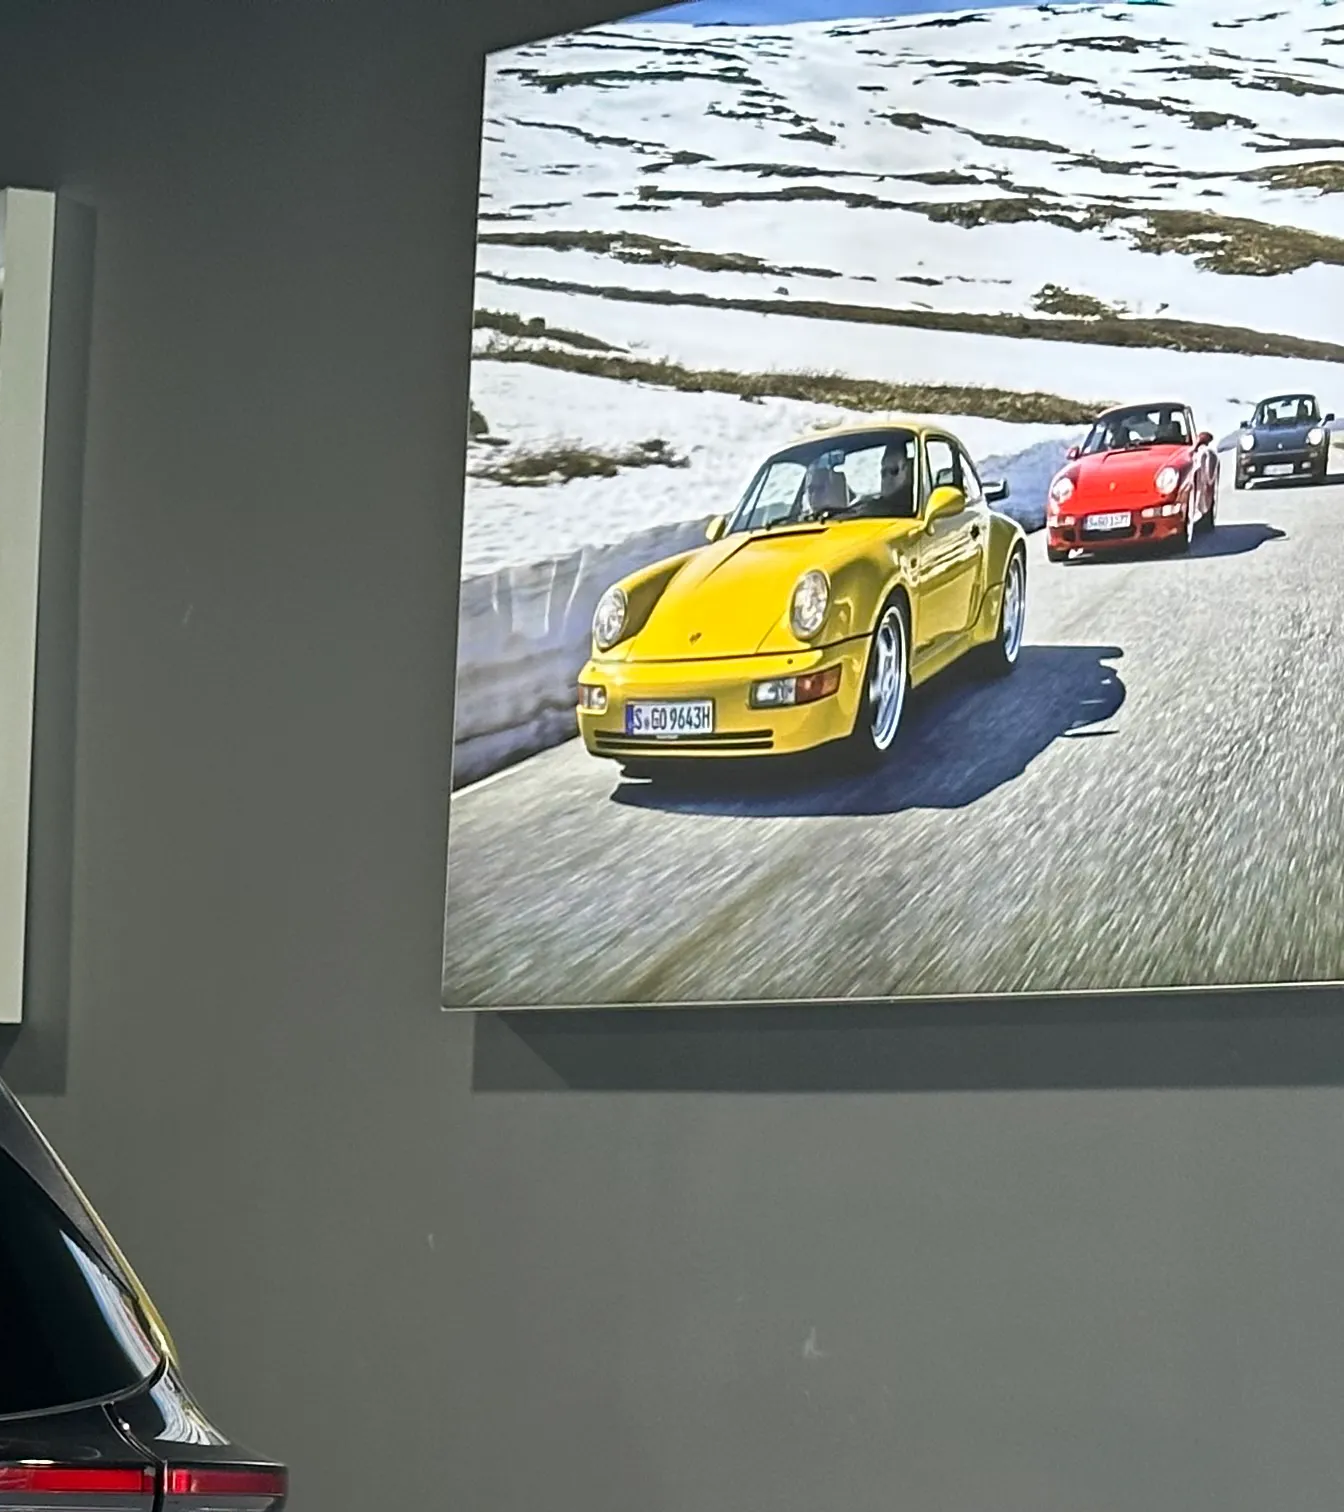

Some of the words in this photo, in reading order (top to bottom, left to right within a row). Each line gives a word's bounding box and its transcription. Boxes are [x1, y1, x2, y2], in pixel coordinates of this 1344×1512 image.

[634, 707, 643, 731] S
[651, 706, 668, 731] GO
[669, 705, 711, 730] 9643H
